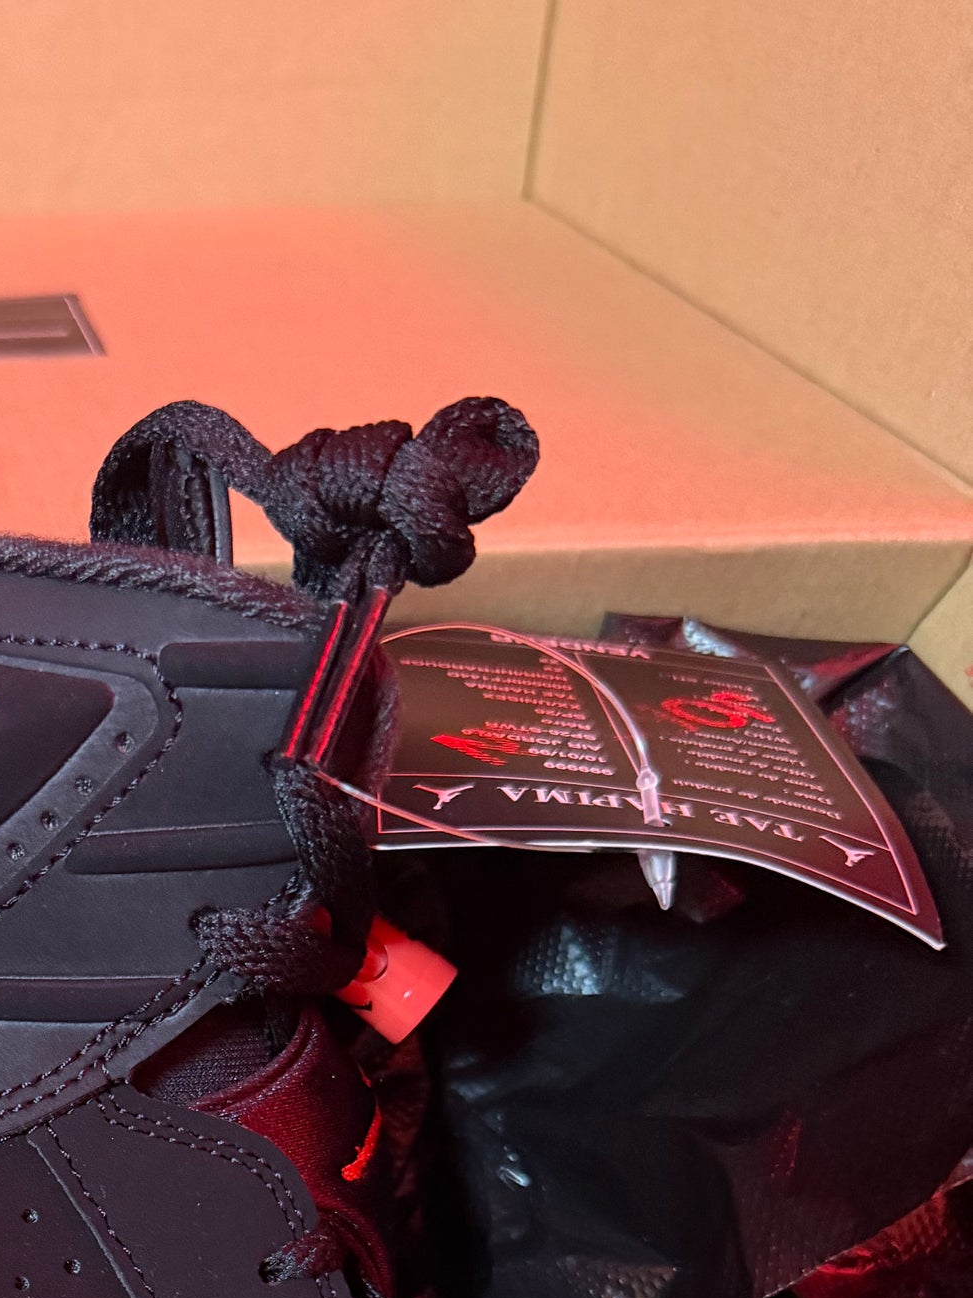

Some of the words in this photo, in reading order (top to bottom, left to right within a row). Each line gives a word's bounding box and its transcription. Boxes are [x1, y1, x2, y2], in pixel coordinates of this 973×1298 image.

[463, 680, 536, 696] HAPIMA
[541, 689, 575, 700] TAE
[568, 739, 602, 752] AIR
[528, 747, 607, 763] 10/01/99
[543, 759, 614, 776] 999999
[672, 779, 733, 794] produit
[784, 778, 824, 792] Nom
[496, 785, 696, 818] HAPIMA
[737, 791, 758, 799] de
[793, 791, 833, 805] Date
[762, 796, 841, 820] Demande
[709, 809, 805, 842] TAE
